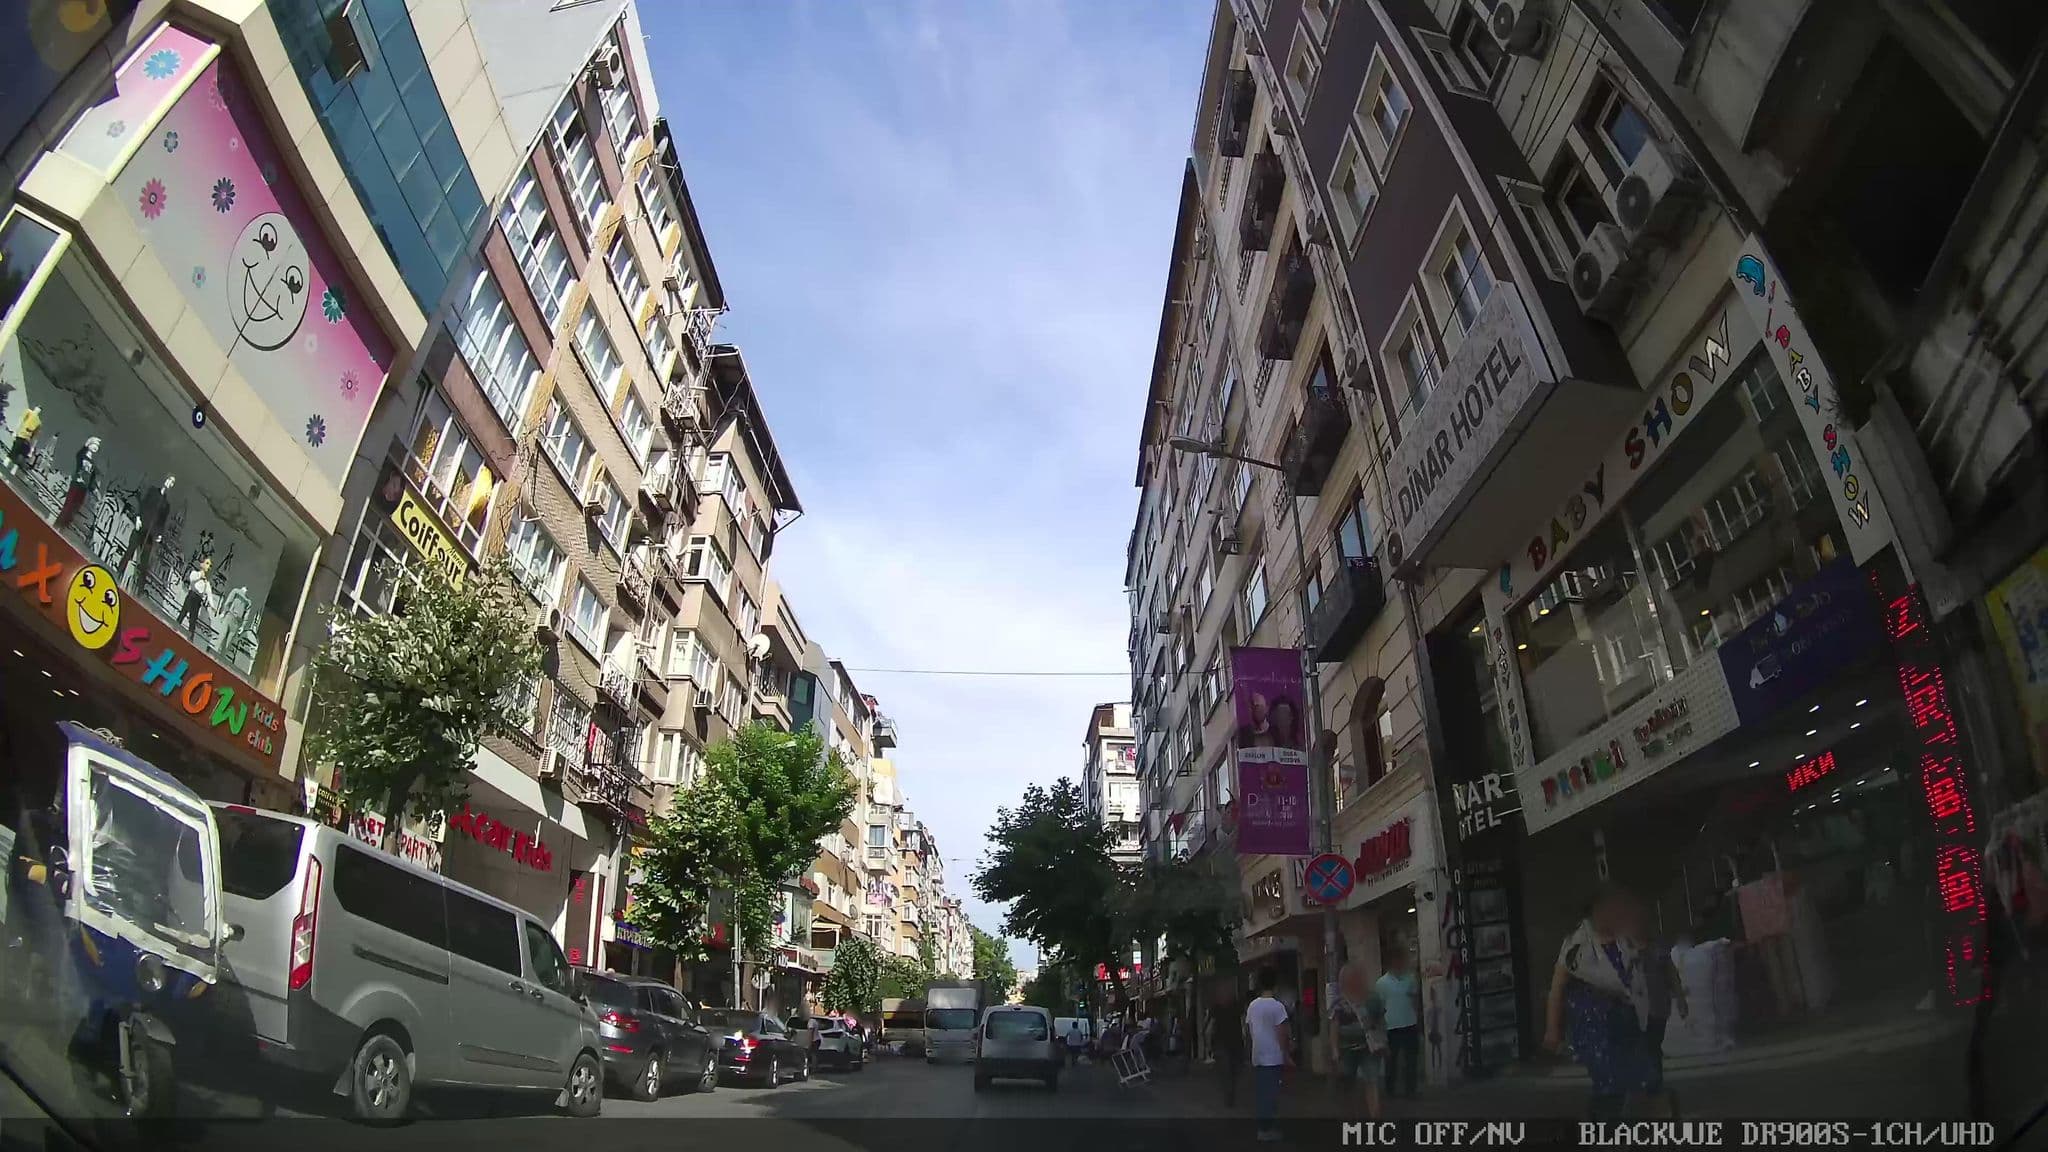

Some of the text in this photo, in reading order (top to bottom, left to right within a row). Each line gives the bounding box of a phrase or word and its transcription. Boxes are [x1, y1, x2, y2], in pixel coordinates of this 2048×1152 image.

[1451, 337, 1523, 459] HOTEL
[1527, 308, 1732, 573] BABY SHOW
[1774, 324, 1871, 530] BABY SHOW
[111, 627, 248, 735] SHOW
[253, 702, 280, 732] kids
[247, 730, 274, 756] club
